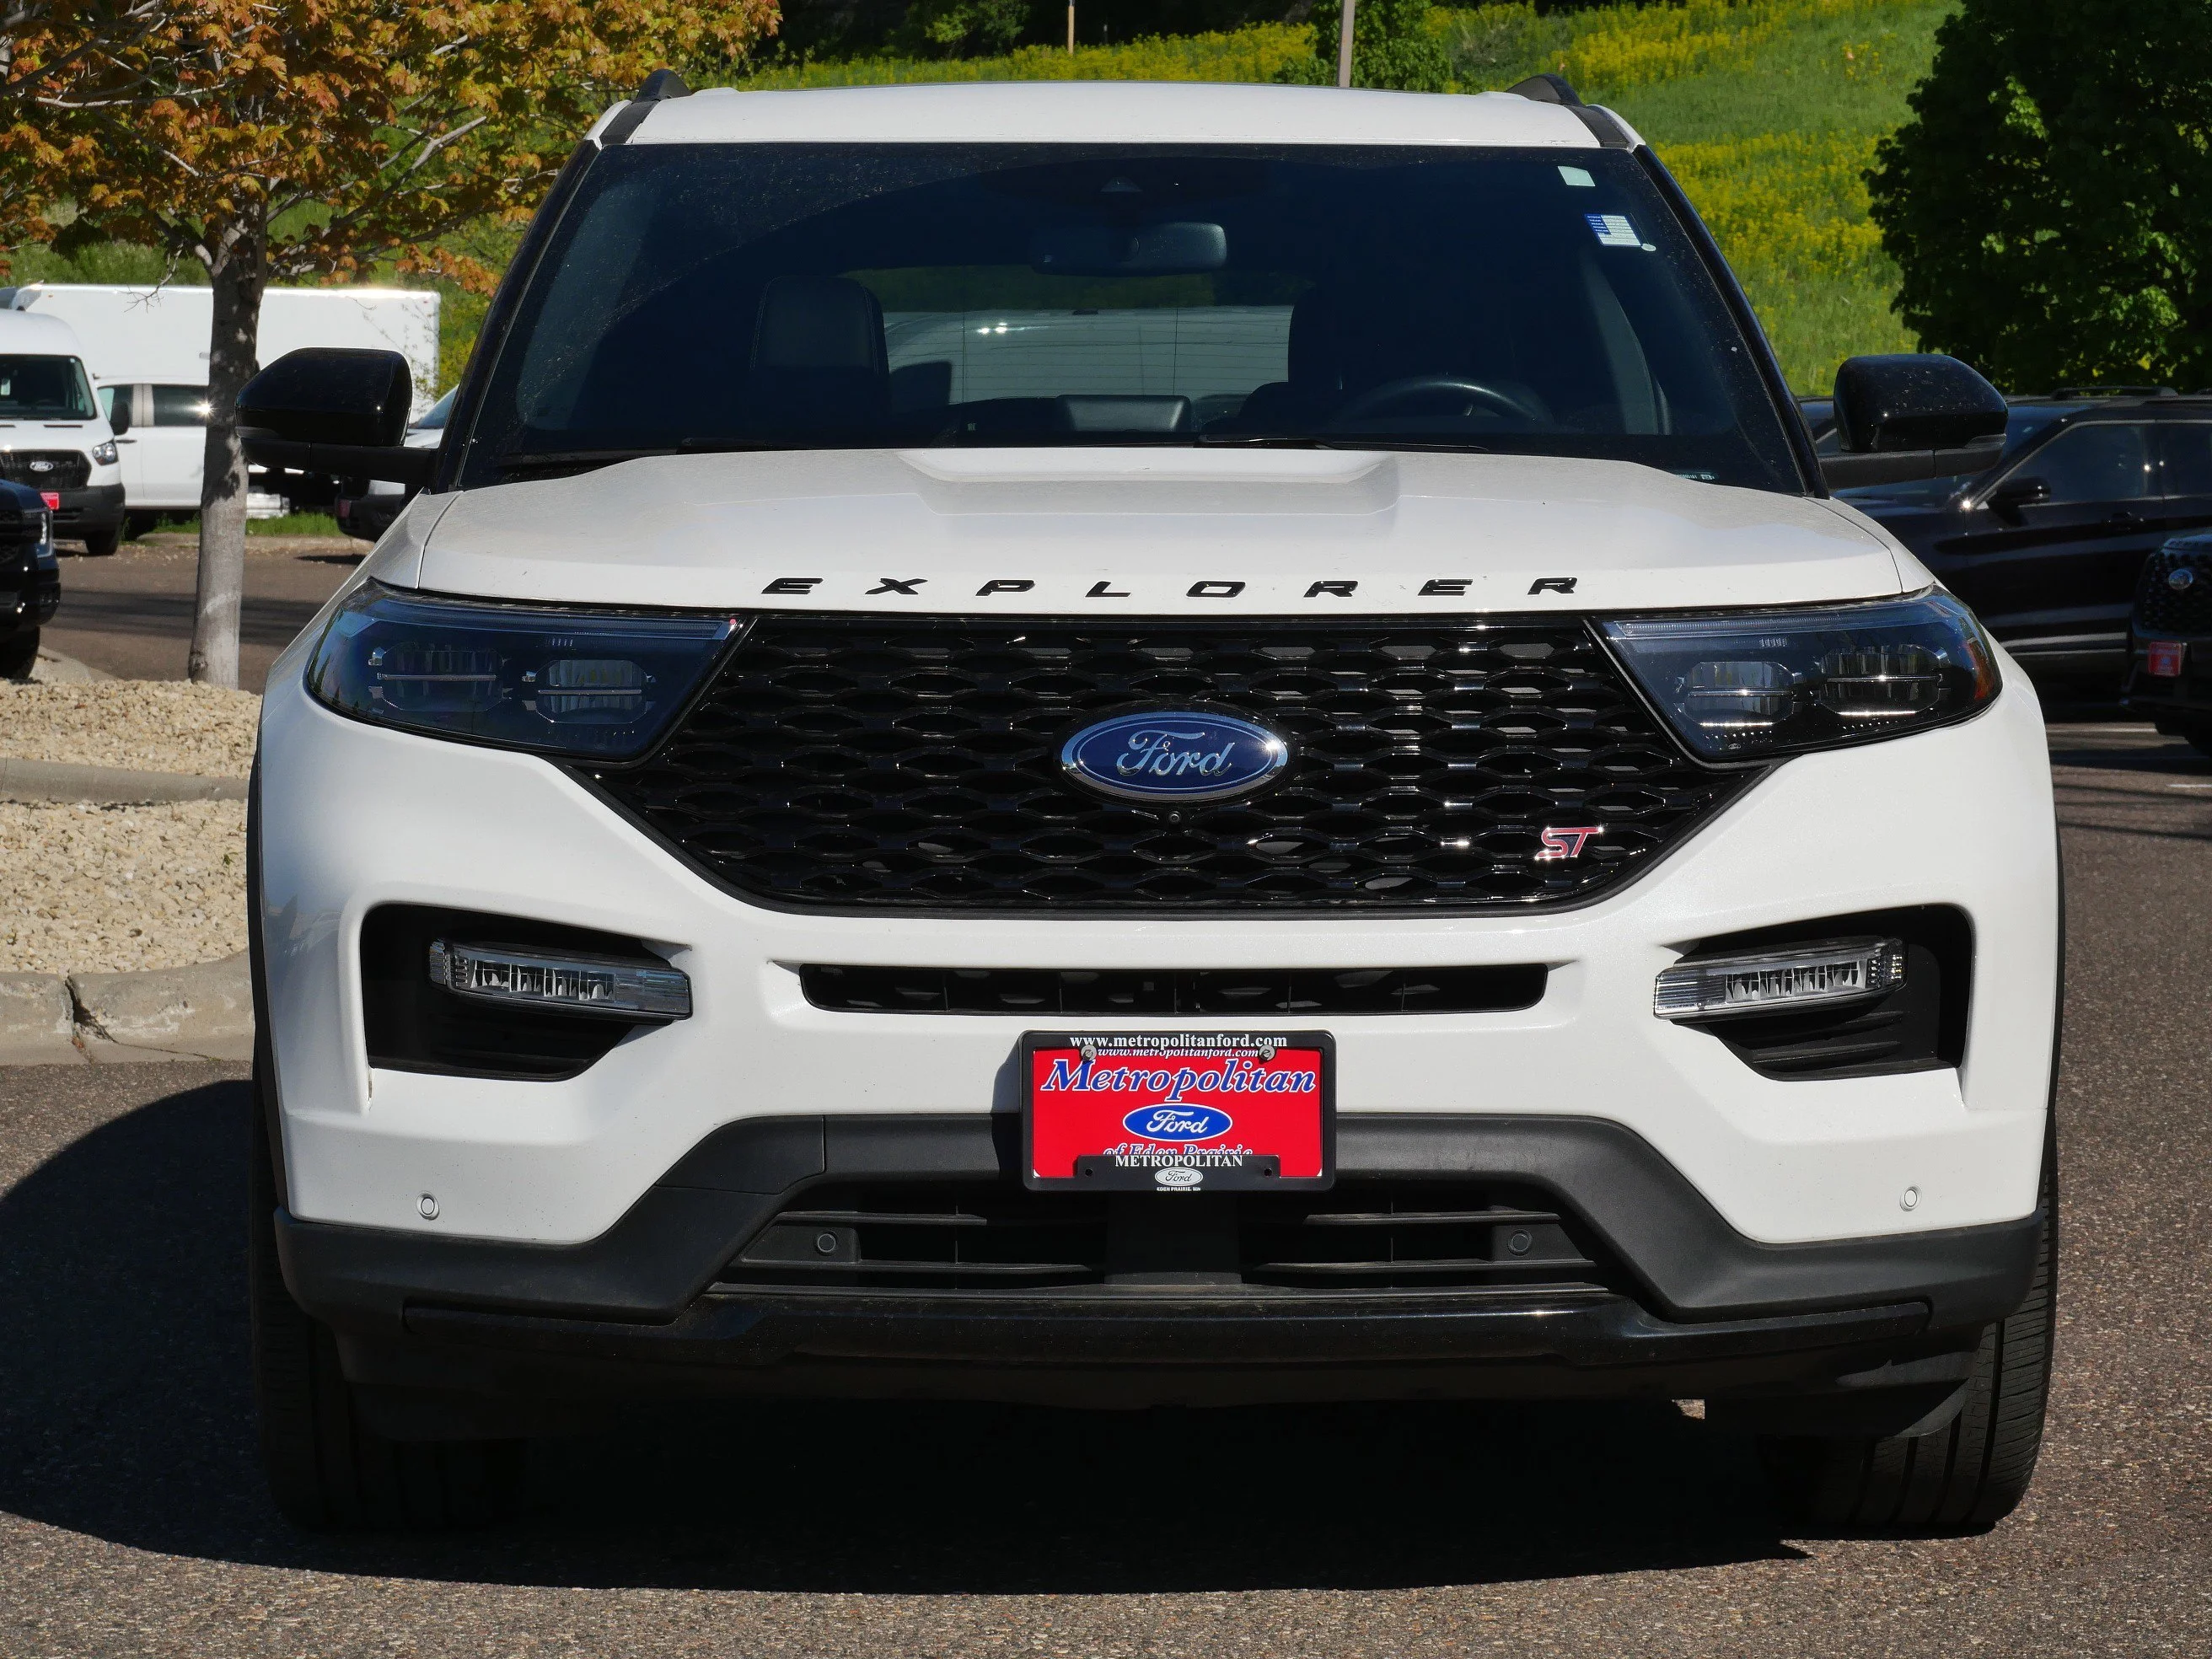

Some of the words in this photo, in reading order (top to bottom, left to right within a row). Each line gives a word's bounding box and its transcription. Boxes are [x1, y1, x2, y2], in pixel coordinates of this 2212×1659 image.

[761, 577, 1578, 598] EXPLORER
[1116, 729, 1236, 776] Ford
[1535, 827, 1603, 858] ST
[1070, 1034, 1288, 1048] www.metropolitanford.com
[1098, 1048, 1258, 1059] www.metropolitanford.com
[1040, 1058, 1317, 1102] Metropolitan
[1146, 1109, 1210, 1134] Ford
[1114, 1154, 1243, 1167] METROPOLITAN
[1165, 1170, 1193, 1182] Ford
